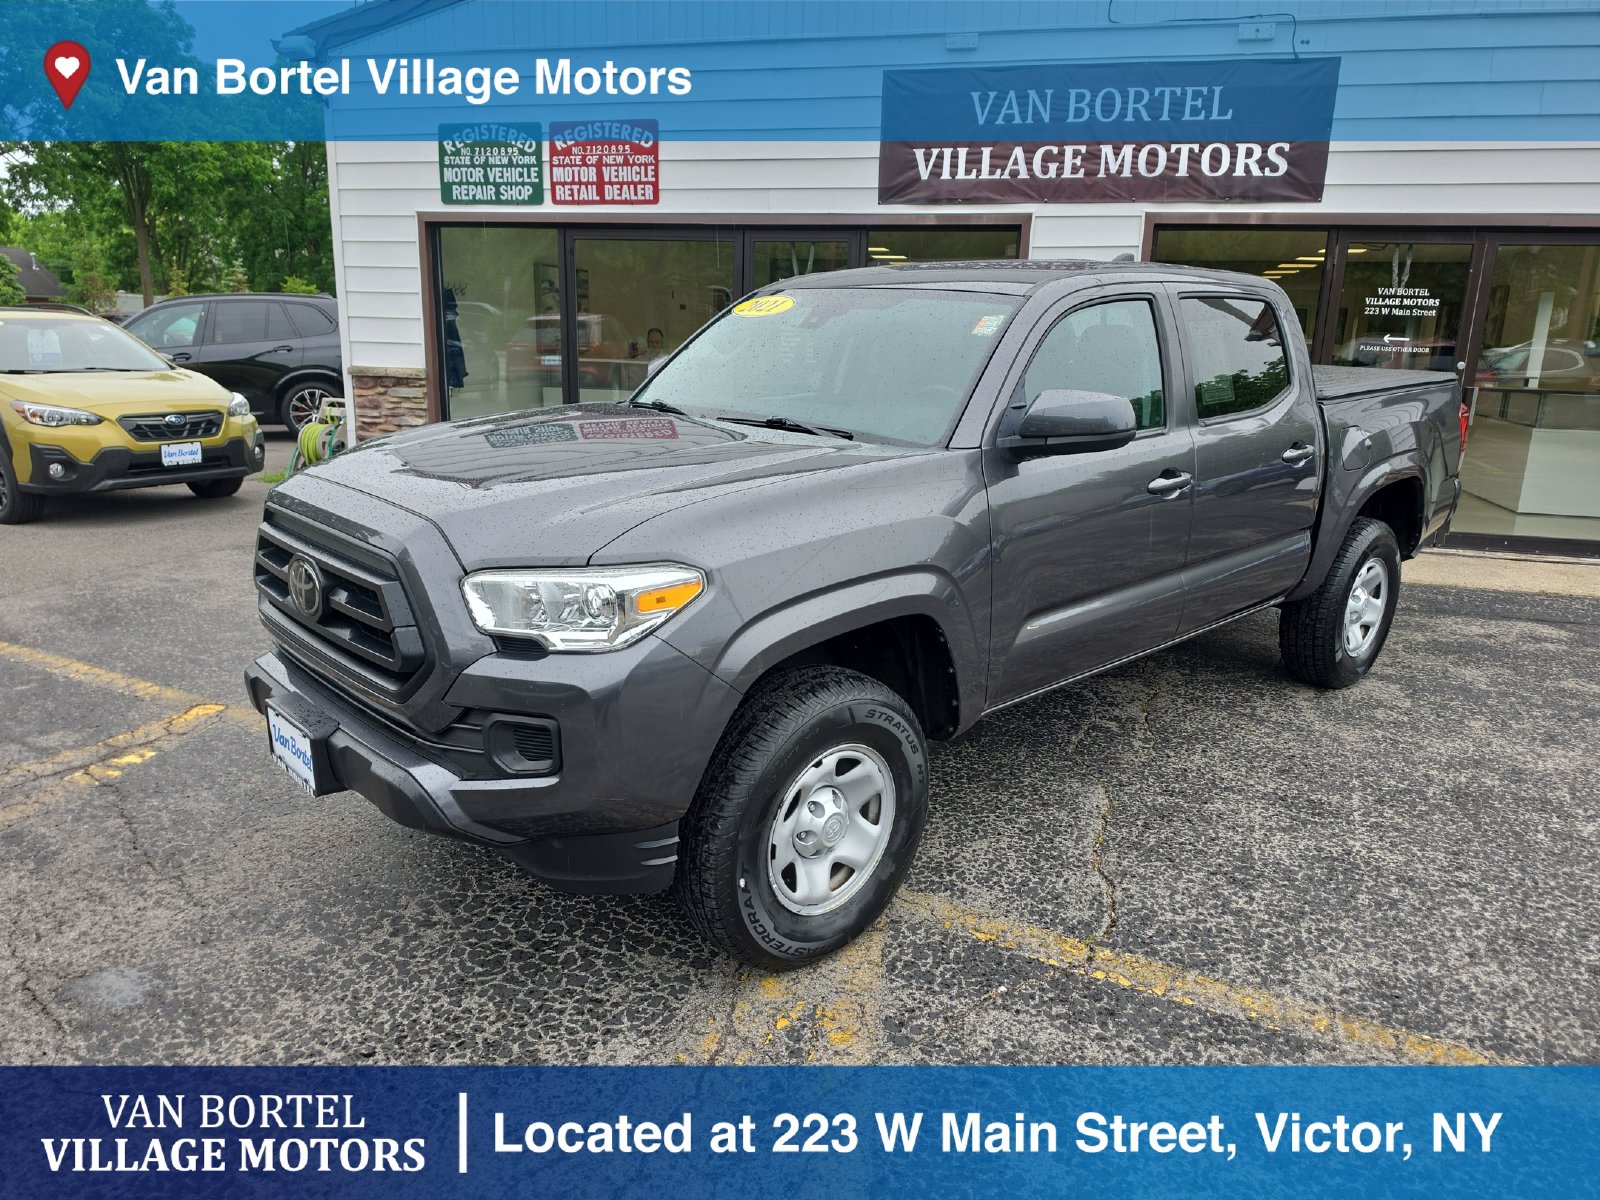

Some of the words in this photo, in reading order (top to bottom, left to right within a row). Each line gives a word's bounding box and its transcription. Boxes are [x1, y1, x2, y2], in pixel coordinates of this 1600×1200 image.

[970, 89, 1054, 125] VAN
[1066, 86, 1234, 123] BORTEL
[443, 124, 536, 154] REGISTERED
[553, 122, 654, 151] REGISTERED
[585, 145, 632, 155] 7120895
[444, 156, 471, 165] STATE
[473, 156, 487, 165] OF
[488, 156, 511, 165] NEW
[511, 156, 537, 165] YORK
[552, 156, 583, 165] STATE
[585, 156, 600, 164] OF
[602, 155, 624, 164] NEW
[627, 155, 656, 164] YORK
[912, 144, 1087, 180] VILLAGE
[1097, 142, 1291, 179] MOTORS
[443, 167, 485, 183] MOTOR
[487, 167, 539, 183] VEHICLE
[552, 166, 597, 183] MOTOR
[602, 165, 656, 182] VEHICLE
[452, 185, 496, 200] REPAIR
[499, 185, 533, 200] SHOP
[555, 185, 601, 201] RETAIL
[604, 184, 654, 200] DEALER
[1377, 287, 1396, 296] VAN
[1396, 287, 1430, 297] BORTEL
[1365, 297, 1402, 306] VILLAGE
[1402, 298, 1441, 308] MOTORS
[1364, 307, 1380, 315] 223
[1381, 307, 1390, 316] W
[1391, 307, 1411, 316] Main
[1412, 308, 1437, 317] Street
[865, 709, 919, 754] STRATUS
[272, 724, 291, 751] Van
[290, 736, 313, 772] Bortel
